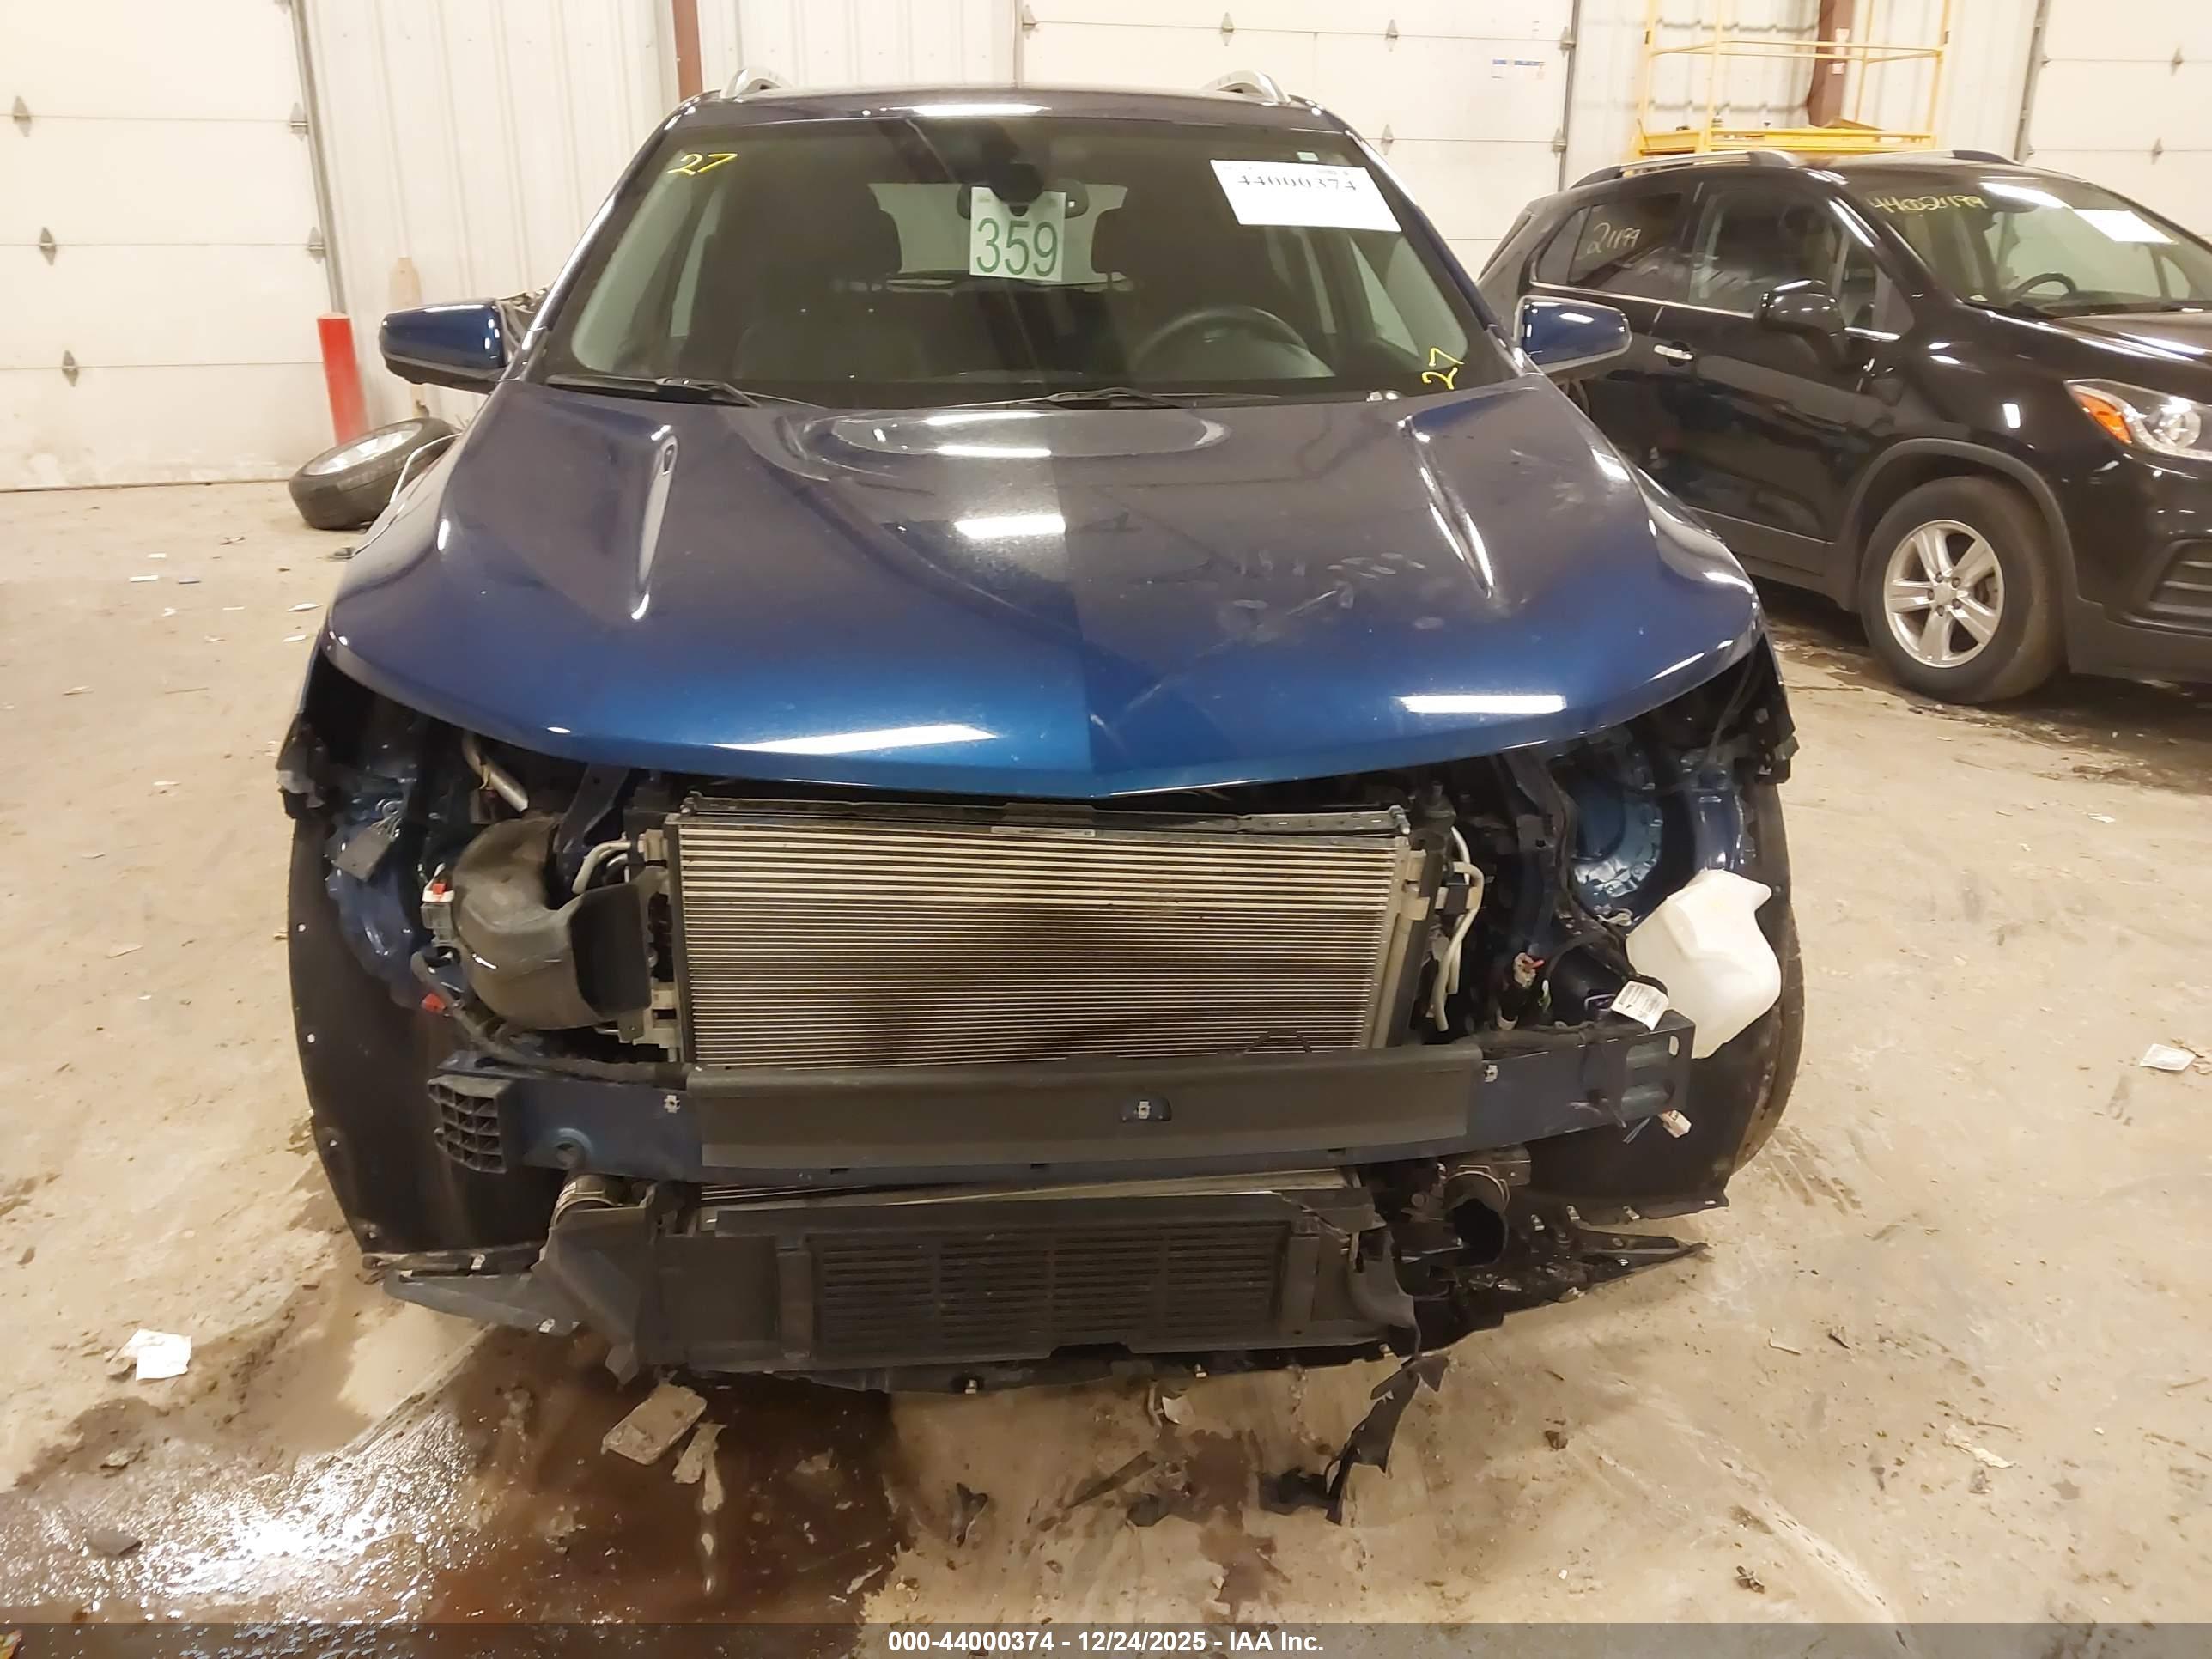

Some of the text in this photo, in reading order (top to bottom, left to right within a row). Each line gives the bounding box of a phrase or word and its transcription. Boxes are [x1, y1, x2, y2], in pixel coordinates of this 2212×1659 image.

[667, 153, 738, 176] 27
[976, 217, 1058, 277] 359
[1421, 347, 1465, 390] 27
